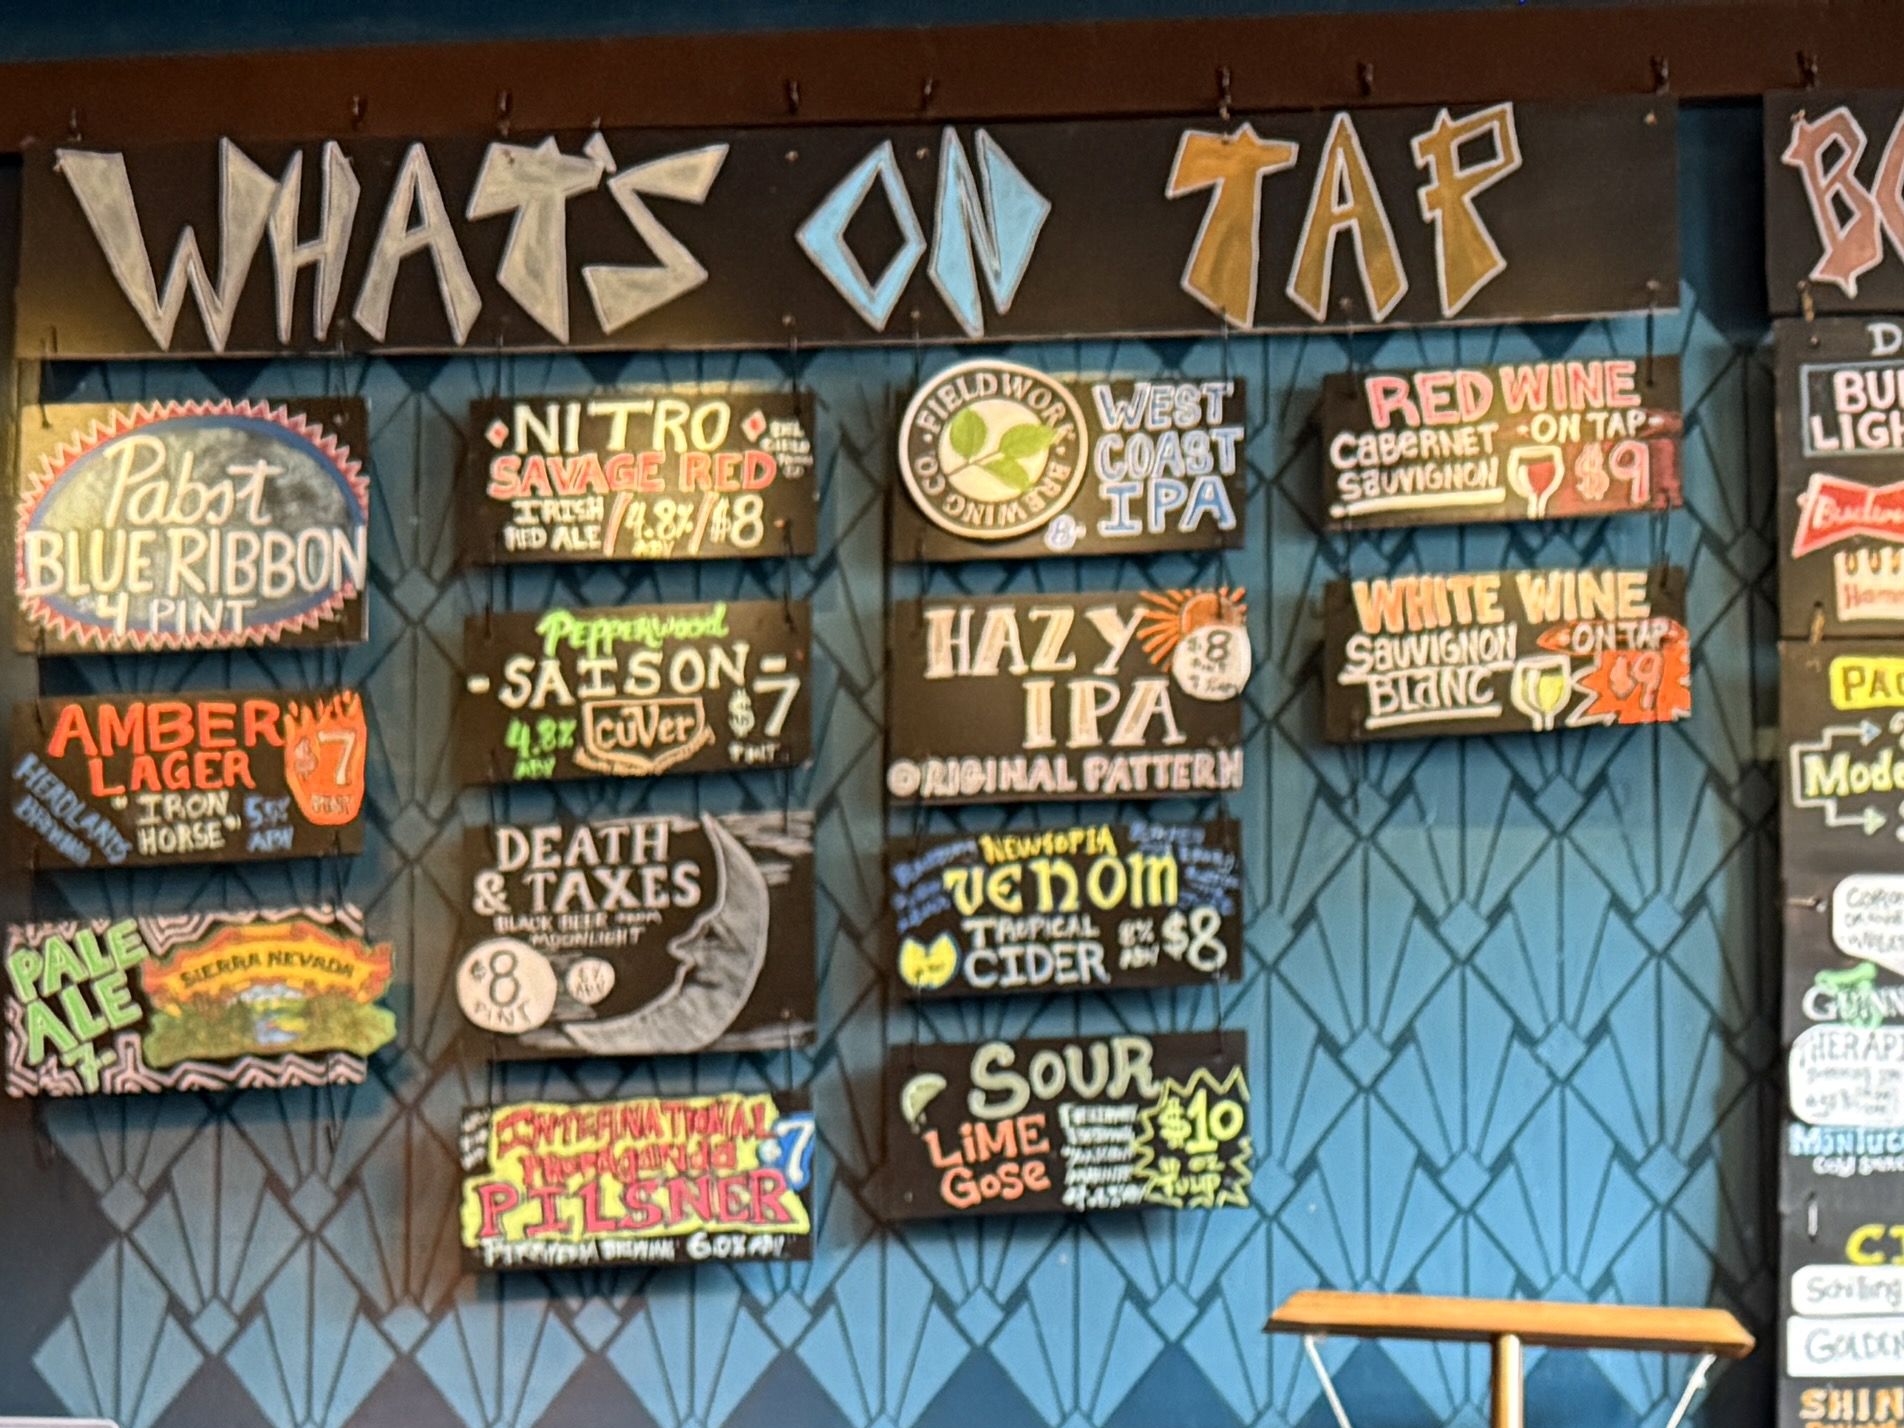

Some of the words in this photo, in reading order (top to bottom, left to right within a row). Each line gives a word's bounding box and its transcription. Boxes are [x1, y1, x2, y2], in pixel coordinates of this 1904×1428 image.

[795, 125, 1052, 338] ON
[1165, 101, 1523, 330] TAP
[915, 372, 1077, 442] FIELDWORK
[1091, 382, 1236, 433] WEST
[1364, 368, 1495, 430] RED
[1498, 359, 1642, 415] WINE
[514, 399, 733, 455] NITRO
[1095, 427, 1246, 481] COAST
[102, 433, 288, 527] Pabst
[486, 451, 669, 500] SAVAGE
[678, 449, 778, 493] RED
[941, 460, 1073, 528] BREWING
[1574, 439, 1652, 505] $9
[510, 496, 605, 527] IRISH
[709, 494, 764, 549] $8
[1097, 475, 1238, 535] IPA
[22, 529, 155, 596] BLUE
[166, 524, 368, 598] RIBBON
[503, 524, 548, 551] RED
[549, 523, 603, 551] ALE
[149, 598, 256, 635] PINT
[1352, 573, 1505, 635] WHITE
[1515, 569, 1651, 625] WINE
[923, 605, 1152, 679] HAZY
[498, 640, 750, 709] SAISON
[46, 699, 286, 758] AMBER
[1021, 676, 1188, 749] IPA
[87, 750, 257, 797] LAGER
[886, 754, 1077, 798] ORIGINAL
[1081, 746, 1245, 794] PATTERN
[495, 820, 671, 873] DEATH
[977, 823, 1118, 865] NEWTOPIA
[472, 870, 512, 917] &
[523, 860, 702, 914] TAXES
[494, 915, 554, 935] BLACK
[558, 912, 608, 933] BEER
[528, 927, 646, 949] MOONLIGHT
[961, 912, 1100, 949] TROPICAL
[1160, 904, 1228, 972] $8
[6, 917, 152, 1004] PALE
[179, 951, 261, 986] SIERRA
[266, 948, 356, 977] NEVADA
[962, 942, 1111, 989] CIDER
[26, 970, 143, 1066] ALE
[967, 1035, 1164, 1121] SOUR
[1157, 1087, 1244, 1155] $10
[477, 1168, 793, 1239] PILSNER
